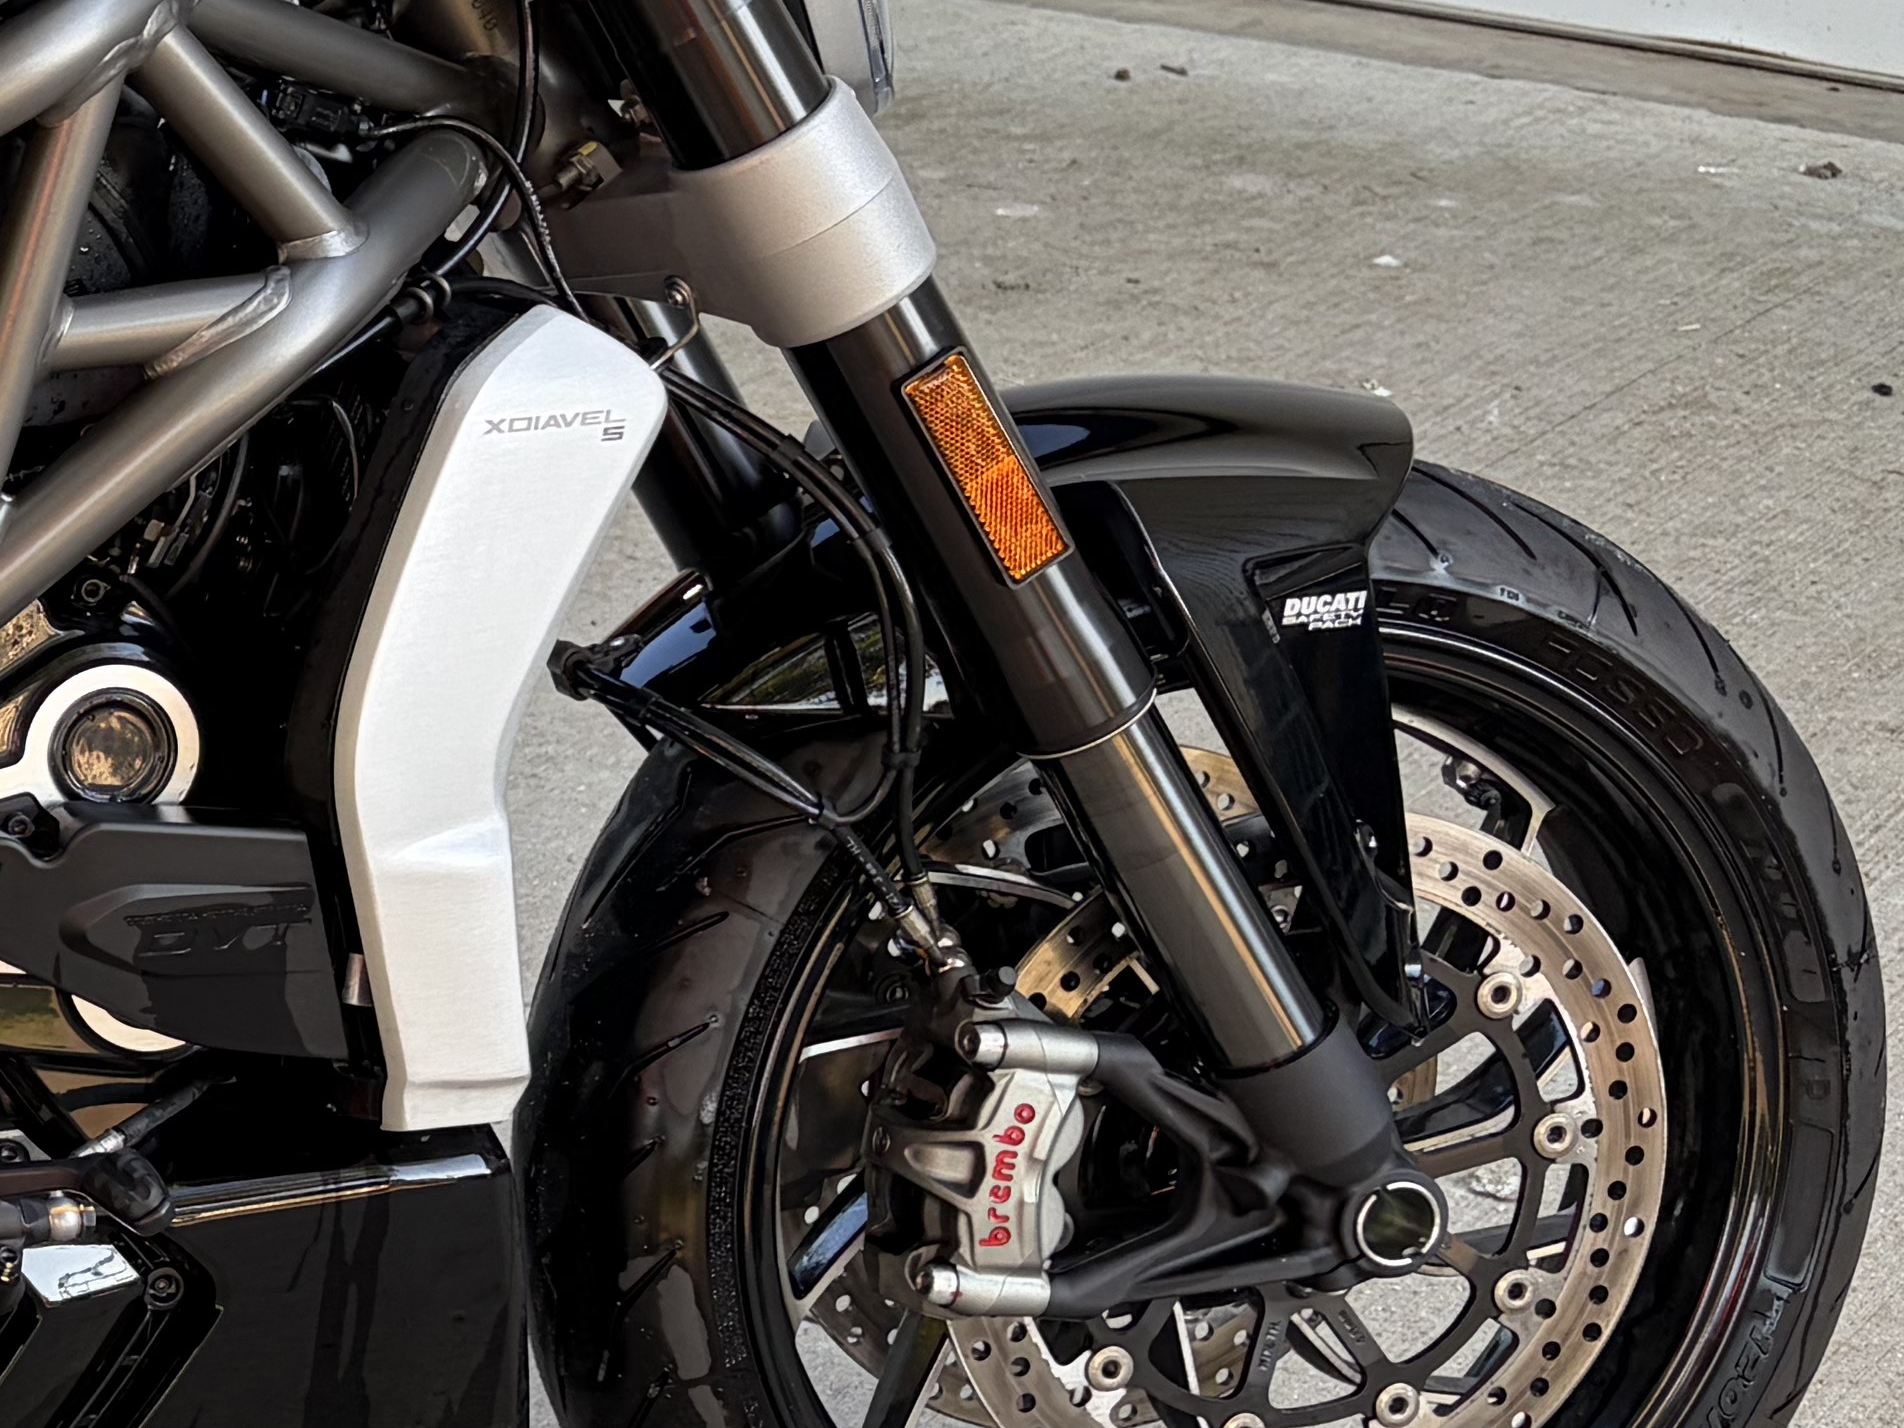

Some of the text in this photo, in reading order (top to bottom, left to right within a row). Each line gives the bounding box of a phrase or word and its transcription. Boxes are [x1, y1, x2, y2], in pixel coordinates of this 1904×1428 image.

[482, 408, 627, 436] XDIAVEL
[600, 426, 625, 442] S
[1282, 589, 1369, 616] DUCATI
[1281, 608, 1364, 627] SAFETY
[978, 1101, 1038, 1250] brembo
